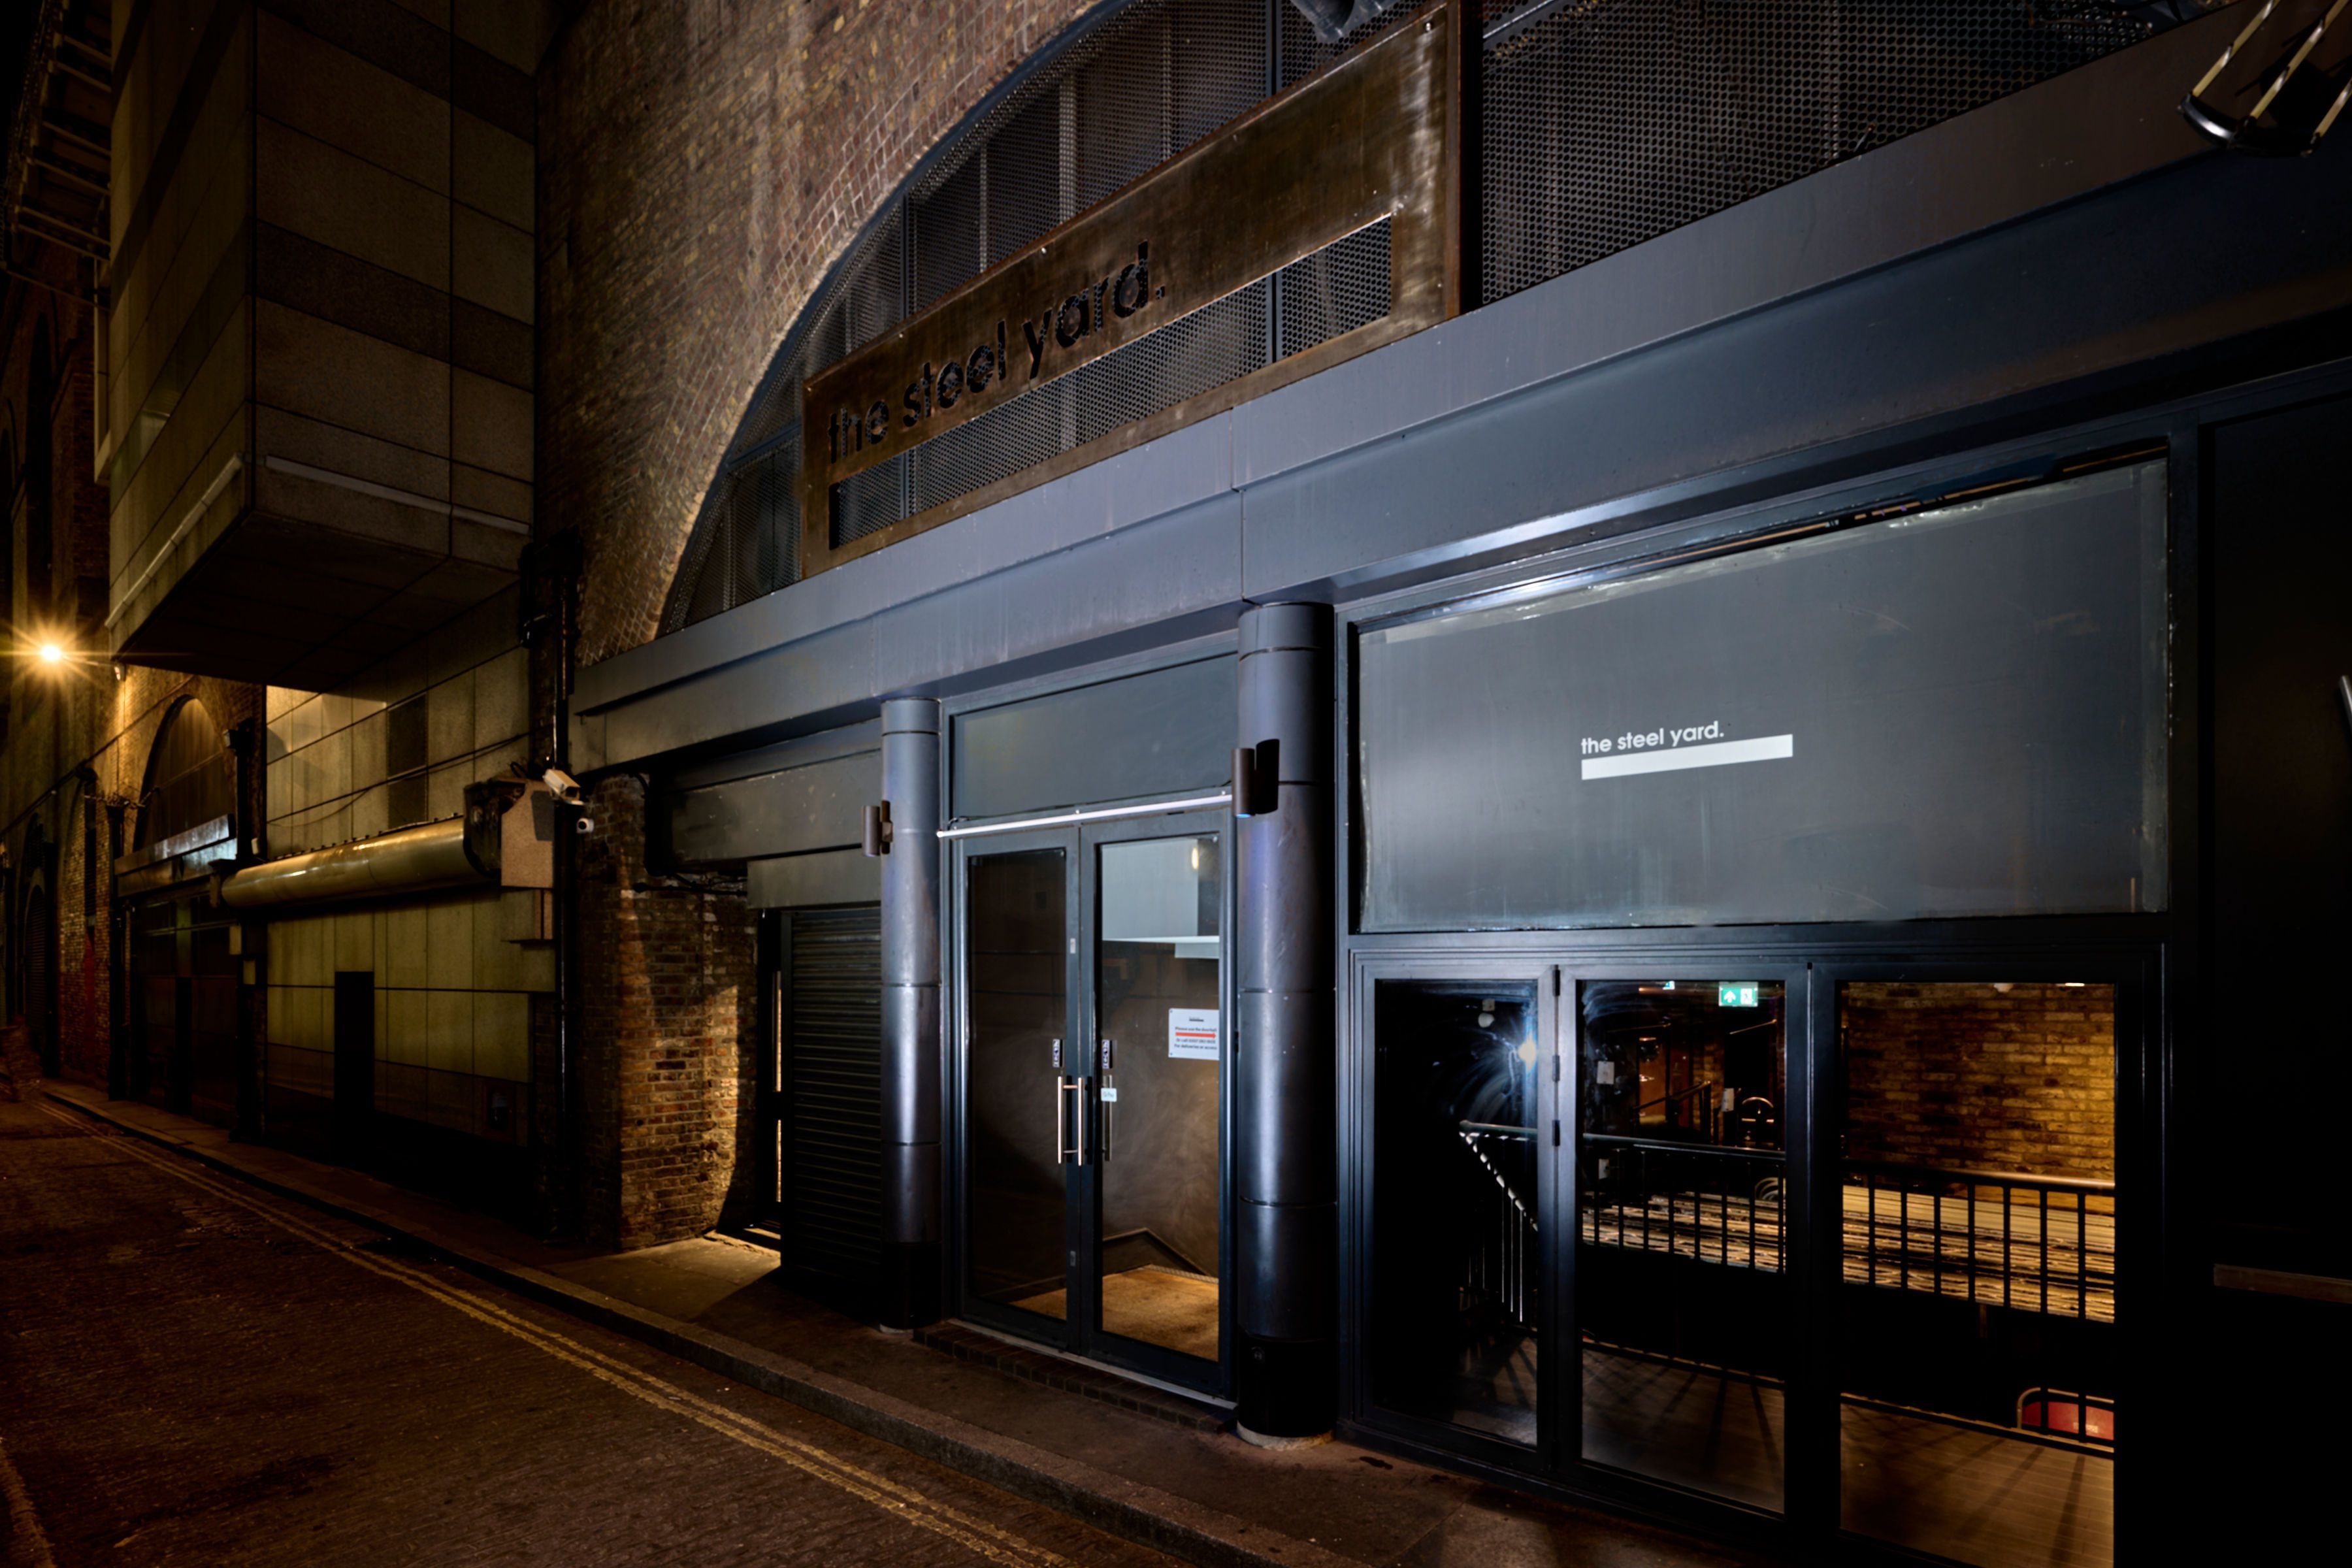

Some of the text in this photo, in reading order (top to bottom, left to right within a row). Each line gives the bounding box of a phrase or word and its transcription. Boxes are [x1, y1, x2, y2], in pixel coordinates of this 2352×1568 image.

[828, 240, 1165, 464] the steel yard.
[1581, 721, 1724, 754] the steel yard.
